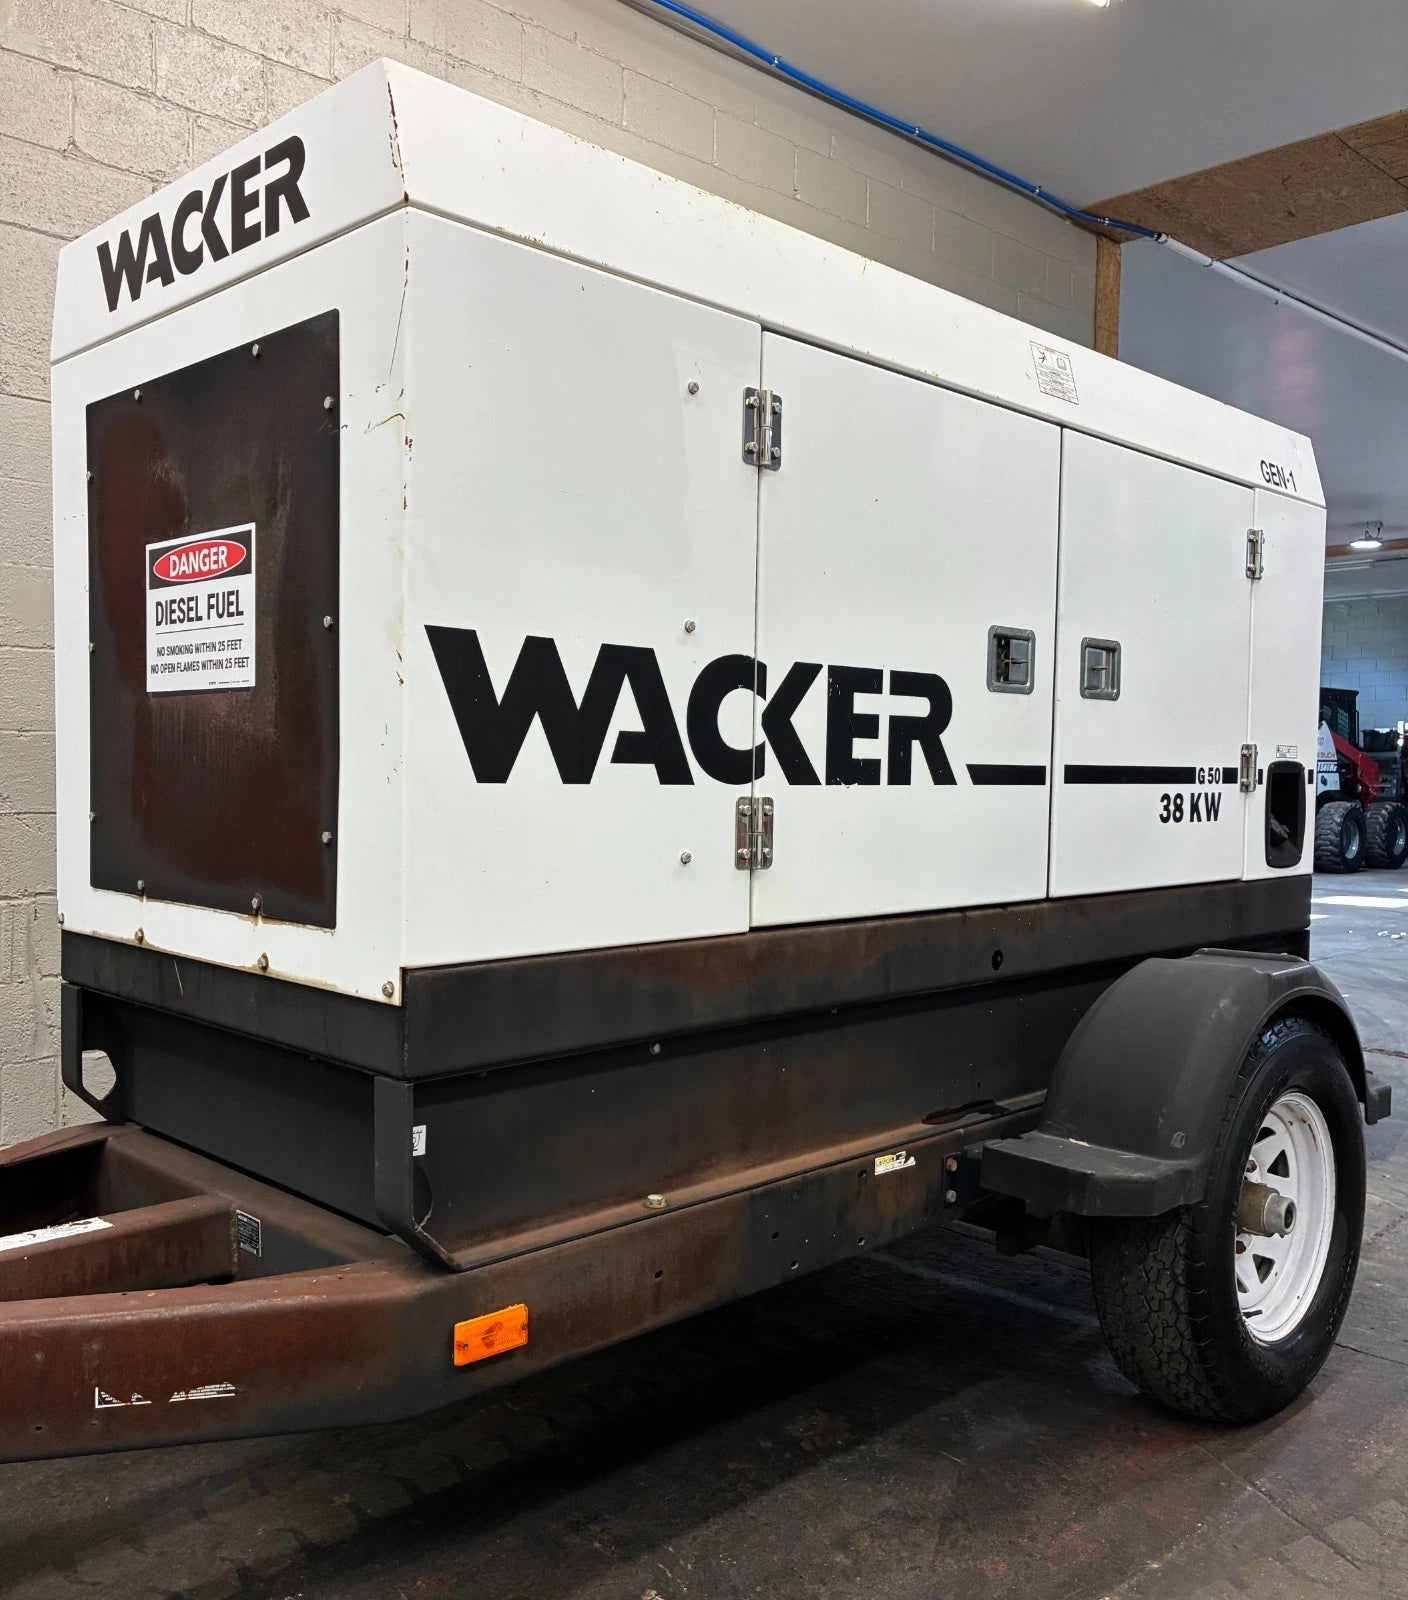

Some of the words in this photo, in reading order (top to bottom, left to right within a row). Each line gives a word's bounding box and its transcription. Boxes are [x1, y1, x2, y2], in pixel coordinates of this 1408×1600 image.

[97, 135, 310, 313] WACKER
[1260, 459, 1297, 493] GEN-1
[169, 545, 228, 577] DANGER
[155, 595, 203, 627] DIESEL
[207, 589, 244, 620] FUEL
[156, 646, 166, 657] NO
[166, 643, 194, 656] SMOKING
[194, 641, 217, 654] WITHIN
[217, 640, 226, 652] 25
[226, 639, 242, 651] FEET
[150, 664, 159, 674] NO
[160, 662, 176, 674] OPEN
[176, 660, 200, 673] FLAMES
[201, 658, 224, 671] WITHIN
[224, 658, 233, 669] 25
[233, 656, 250, 669] FEET
[424, 625, 957, 786] WACKER
[1159, 793, 1184, 824] 38
[1189, 792, 1222, 823] KW
